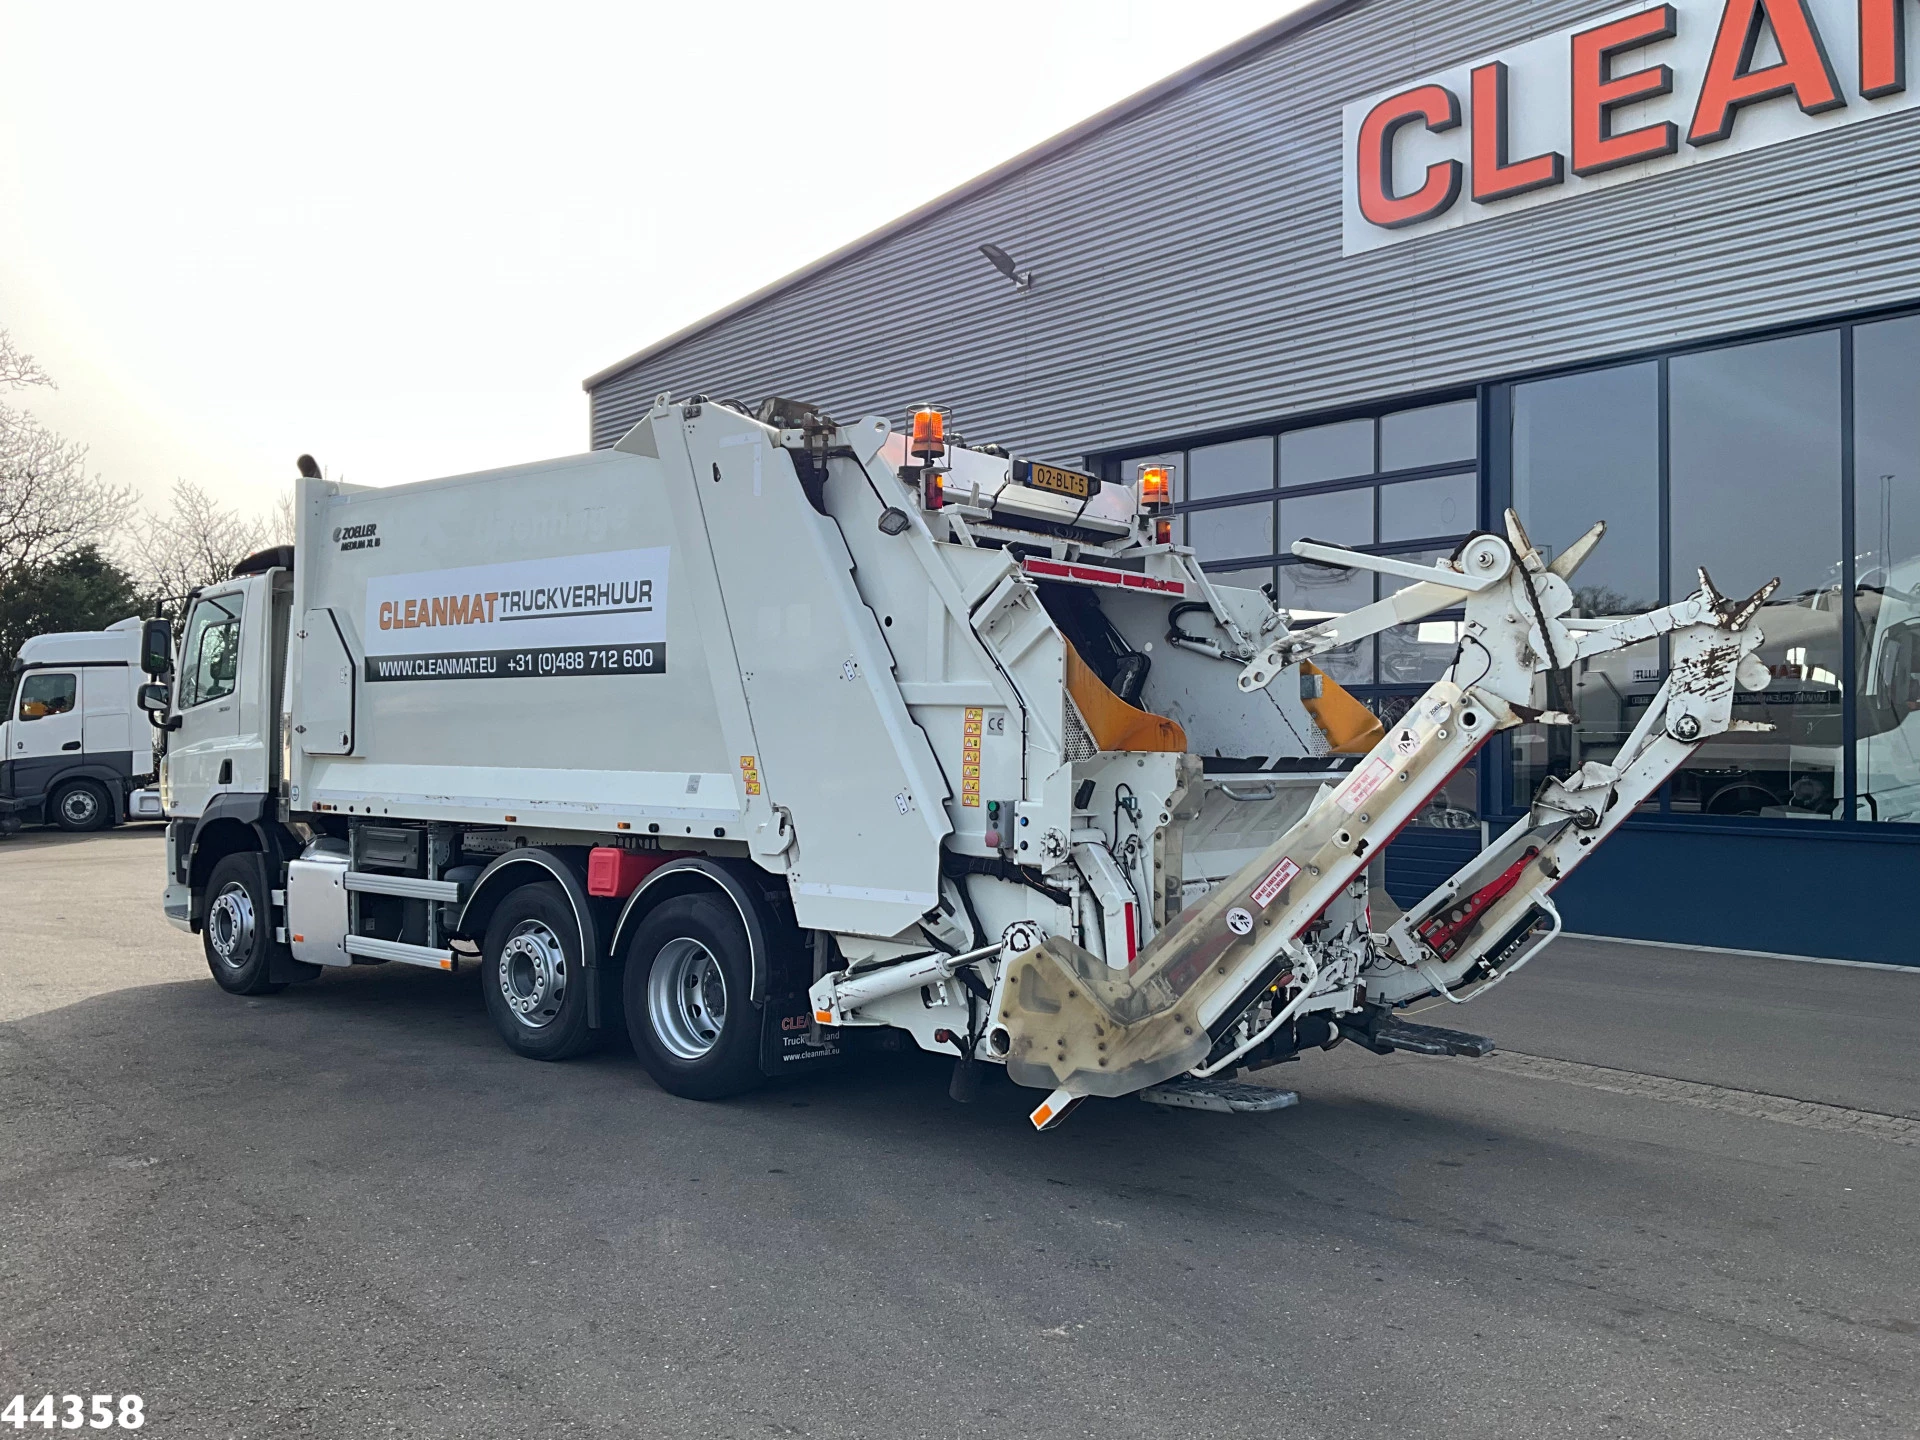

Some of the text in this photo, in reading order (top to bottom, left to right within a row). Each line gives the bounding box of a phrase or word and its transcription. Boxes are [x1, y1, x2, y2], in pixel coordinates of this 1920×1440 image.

[1037, 468, 1084, 493] 02-BLT-5
[341, 523, 377, 540] ZOELLER
[379, 580, 653, 630] CLEANMAT TRUCKVERHUUR
[378, 648, 653, 677] WWW.CLEANMAT.EU +31 (0)488 712 600
[988, 717, 1004, 731] CE
[783, 1036, 805, 1046] Truck
[783, 1048, 840, 1061] www.cleanmat.eu
